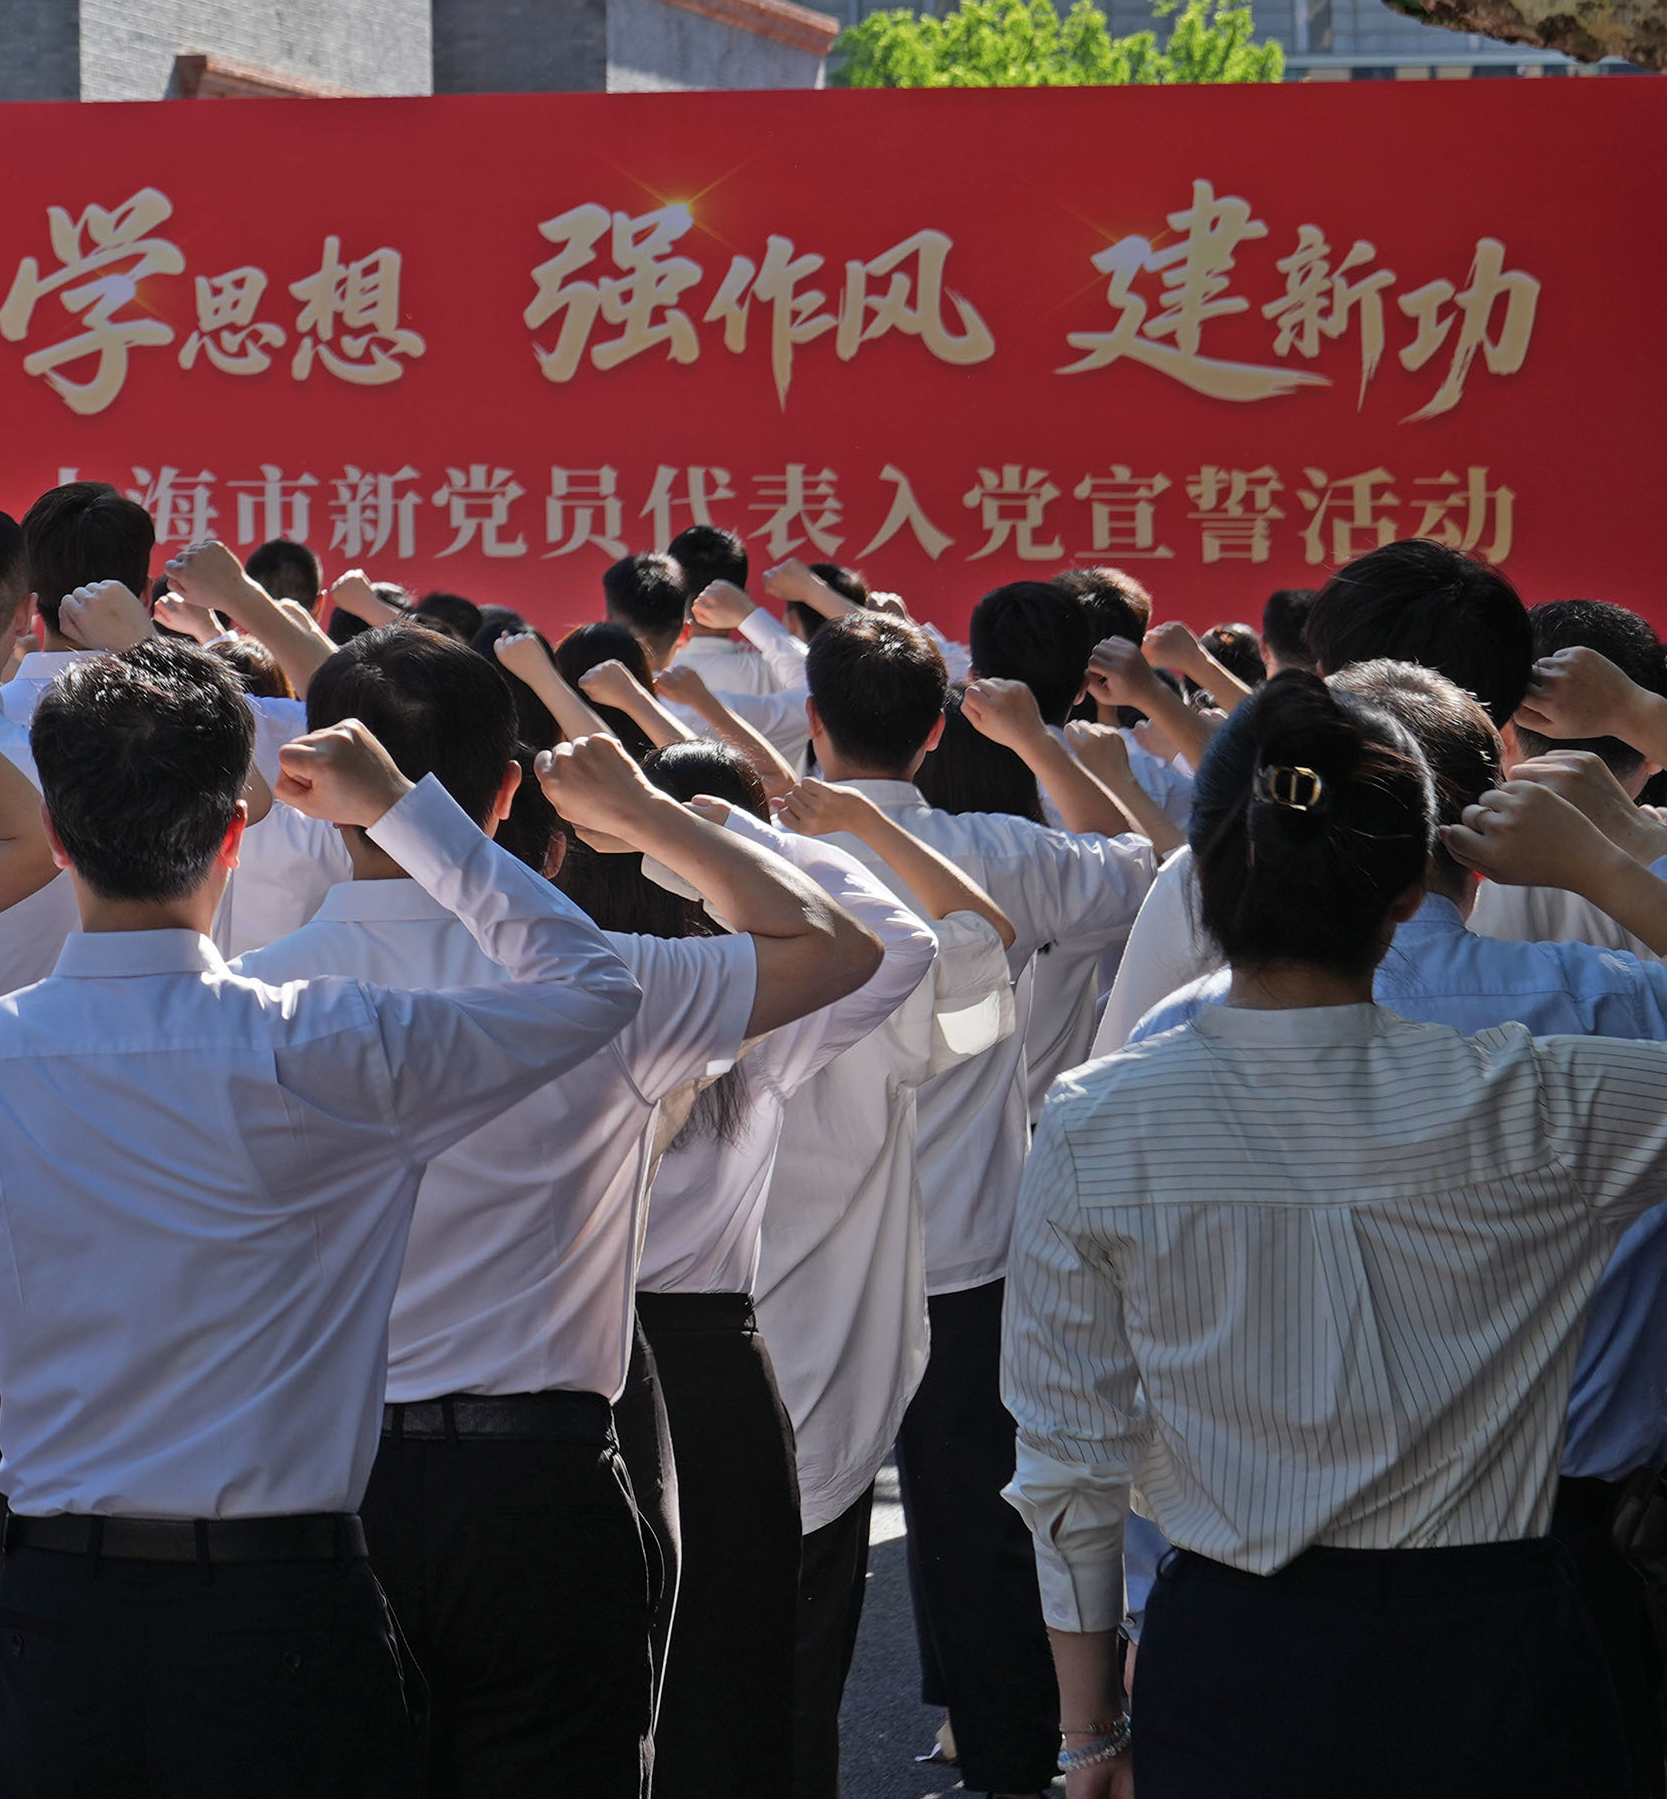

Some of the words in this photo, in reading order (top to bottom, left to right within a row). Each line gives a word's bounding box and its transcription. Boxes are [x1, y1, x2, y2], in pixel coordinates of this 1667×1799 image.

[522, 200, 996, 413] 强作风
[1055, 177, 1541, 424] 建新功
[57, 462, 1517, 565] 海市新党员代表入党宣誓活动
